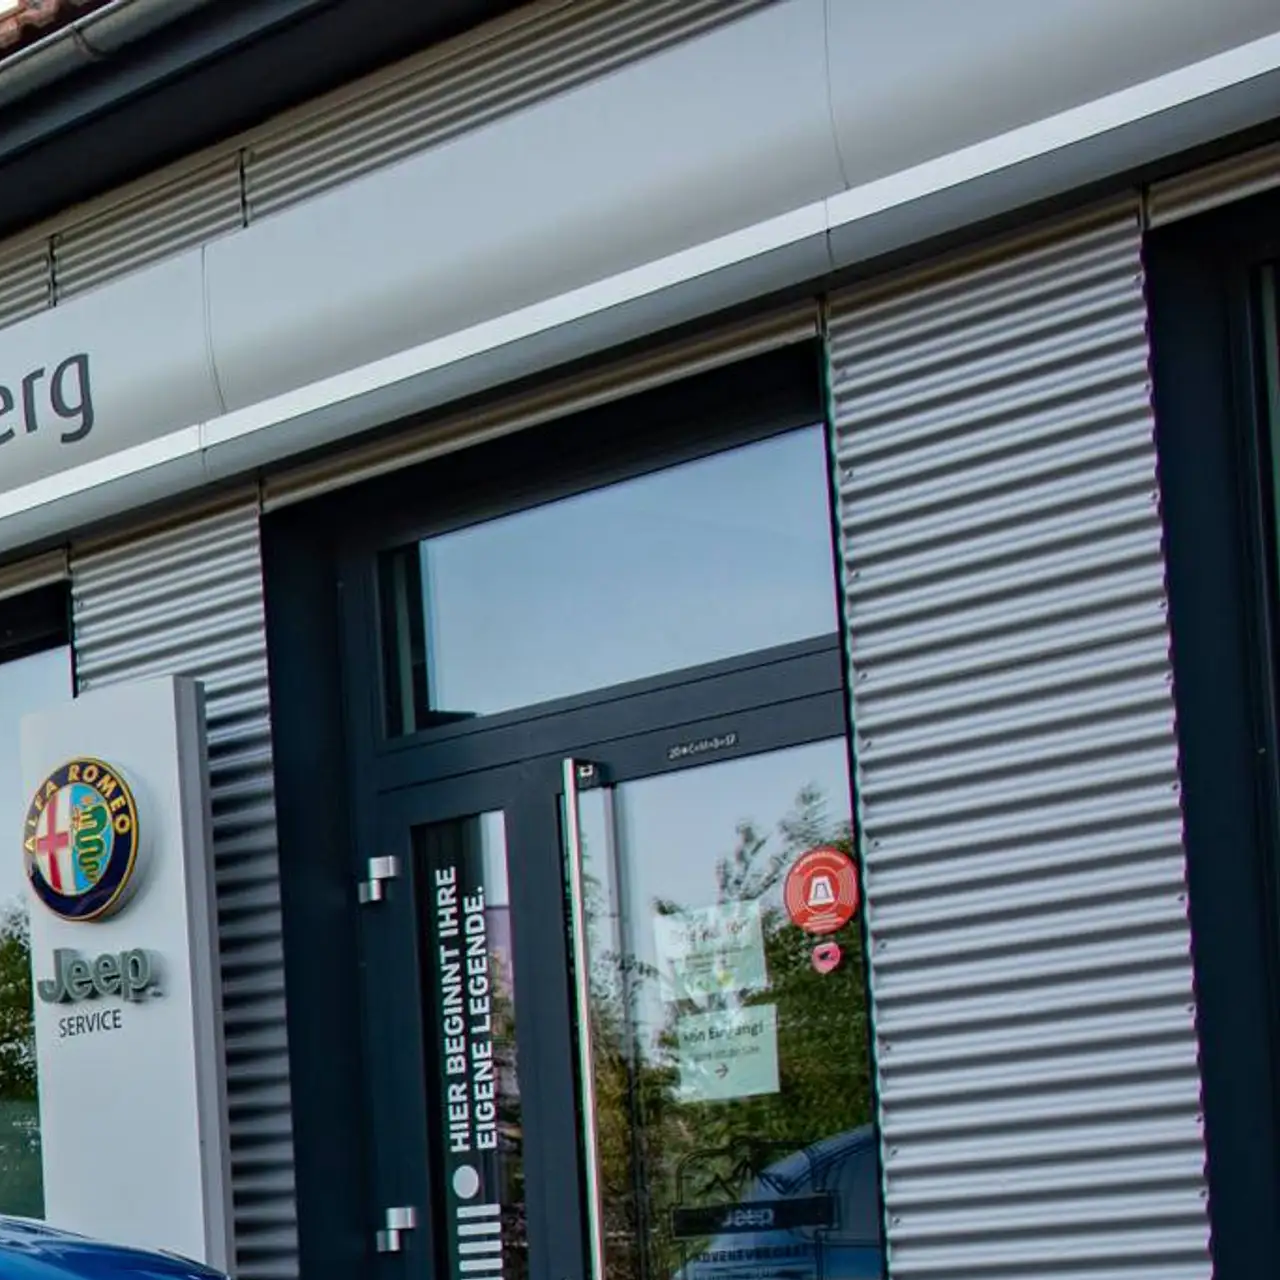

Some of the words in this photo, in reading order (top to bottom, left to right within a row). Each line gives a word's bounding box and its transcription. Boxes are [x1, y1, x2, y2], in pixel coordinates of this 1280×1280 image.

[23, 780, 59, 853] ALFA
[68, 763, 131, 835] ROMEO
[435, 865, 459, 938] IHRE
[37, 947, 153, 1003] Jeep
[464, 885, 491, 1036] LEGENDE.
[58, 1008, 123, 1038] SERVICE
[441, 945, 466, 1076] BEGINNT
[449, 1081, 471, 1153] HIER
[472, 1040, 498, 1150] EIGENE
